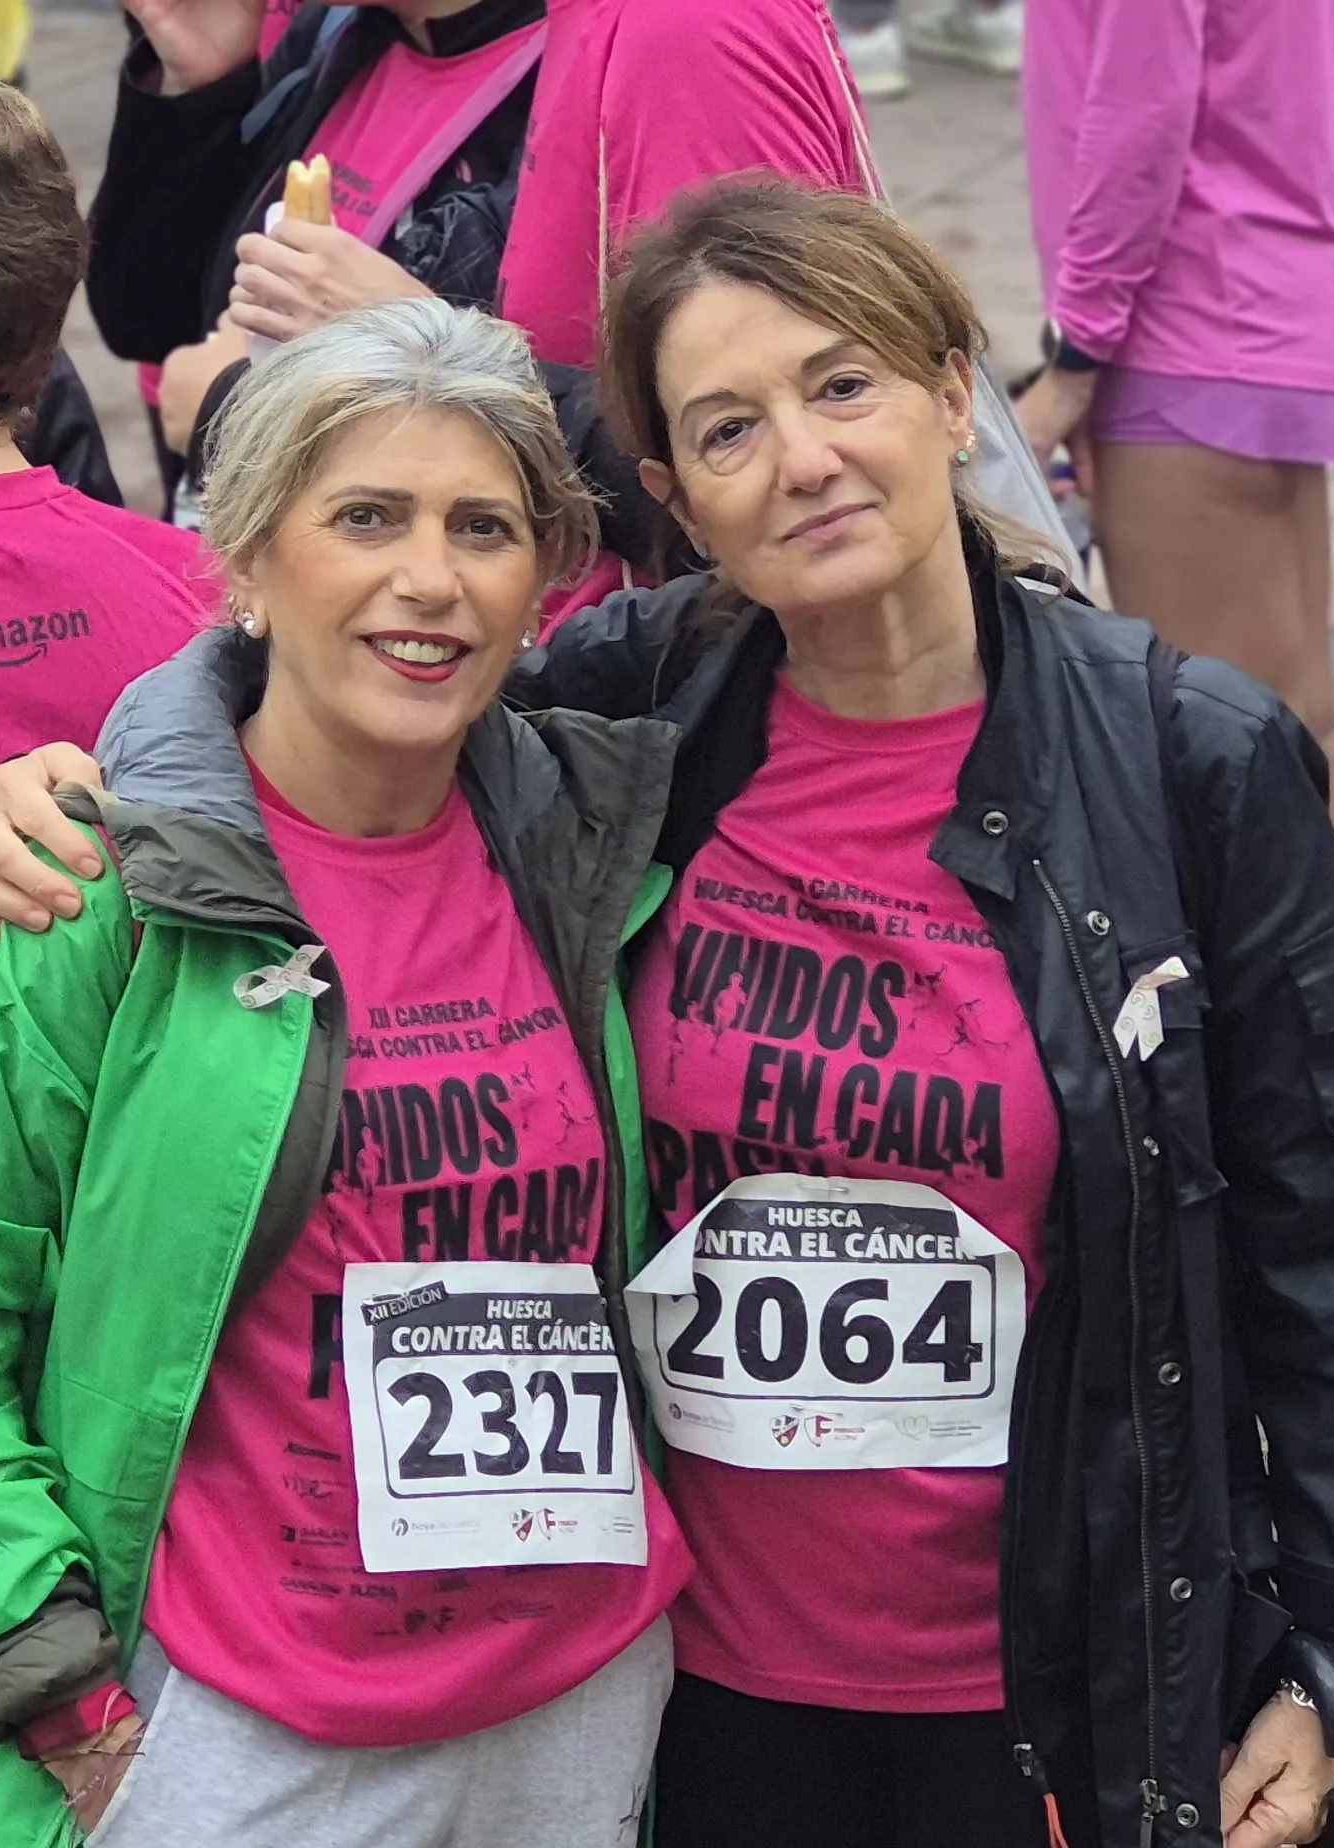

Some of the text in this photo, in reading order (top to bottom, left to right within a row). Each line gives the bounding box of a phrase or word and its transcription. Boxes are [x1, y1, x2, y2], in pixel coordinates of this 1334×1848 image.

[695, 876, 788, 918] HUESCA
[884, 913, 915, 938] EL
[670, 923, 906, 1059] UNIDOS
[395, 997, 496, 1028] CARRERA
[379, 1031, 463, 1058] CONTRA
[464, 1029, 494, 1051] EL
[737, 1041, 1004, 1179] EN CADA
[402, 1184, 472, 1262] EN
[768, 1207, 863, 1229] HUESCA
[695, 1228, 791, 1258] NTRA
[800, 1232, 836, 1258] EL
[368, 1287, 443, 1322] XII EDICIÓN
[487, 1299, 552, 1320] HUESCA
[391, 1324, 505, 1354] CONTRA
[511, 1325, 534, 1351] EL
[667, 1273, 982, 1384] 2064
[387, 1370, 618, 1480] 2327
